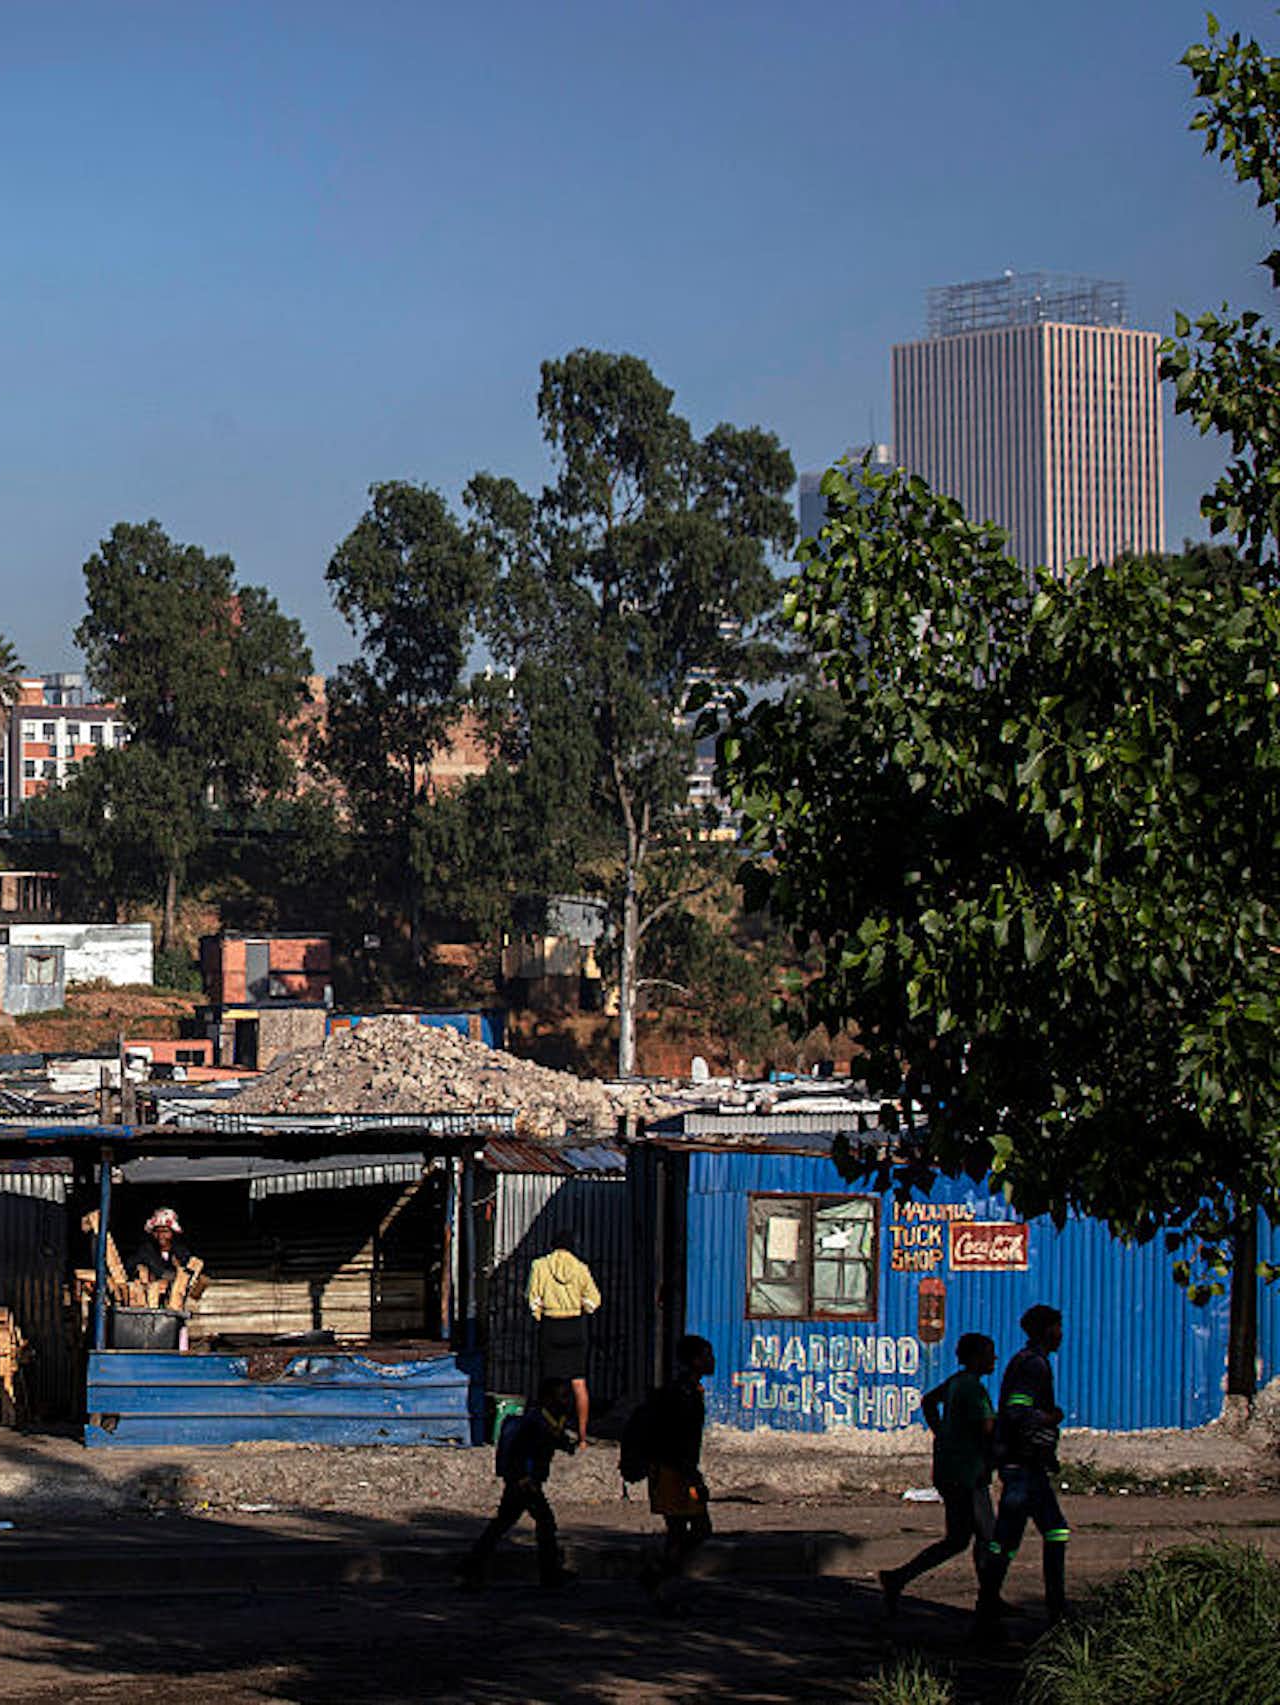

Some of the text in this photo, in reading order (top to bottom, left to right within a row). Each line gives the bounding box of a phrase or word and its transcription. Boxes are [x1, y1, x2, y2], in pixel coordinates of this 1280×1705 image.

[889, 1225, 942, 1248] TUCK
[891, 1249, 944, 1272] SHOP
[750, 1333, 920, 1375] MADONDO
